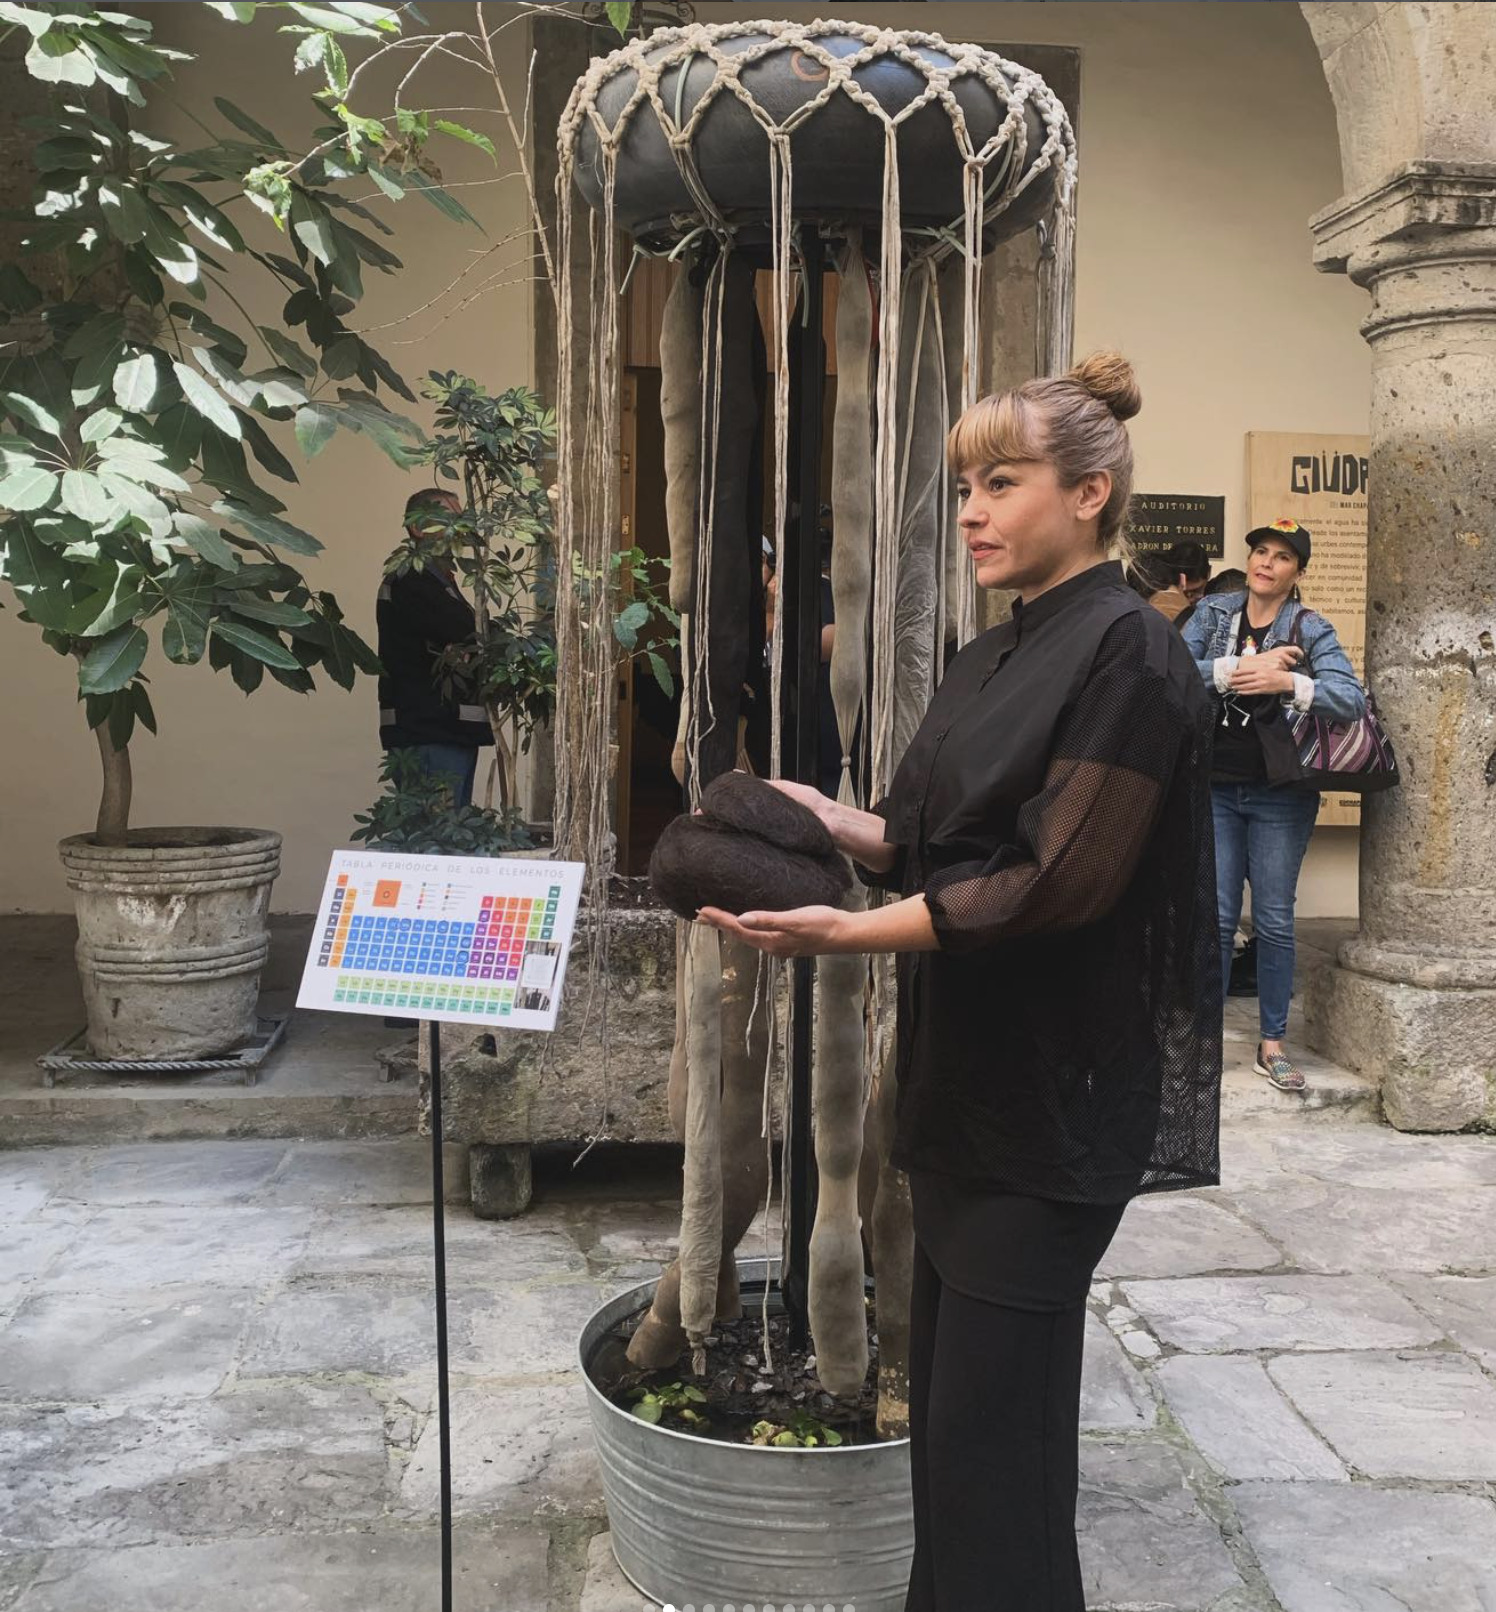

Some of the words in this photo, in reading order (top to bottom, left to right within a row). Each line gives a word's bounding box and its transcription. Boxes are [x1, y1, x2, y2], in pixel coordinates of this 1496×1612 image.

[1141, 502, 1206, 511] AUDITORIO
[1334, 519, 1349, 527] agua
[1129, 525, 1169, 534] XAVIER
[1176, 526, 1216, 535] TORRES
[1328, 529, 1338, 537] los
[1130, 542, 1160, 551] ADRON
[1320, 540, 1338, 548] urbes
[1327, 574, 1363, 582] comunidad
[341, 859, 374, 869] TABLA
[446, 864, 463, 874] DE
[470, 865, 491, 875] LOS
[498, 866, 565, 879] ELEMENTOS
